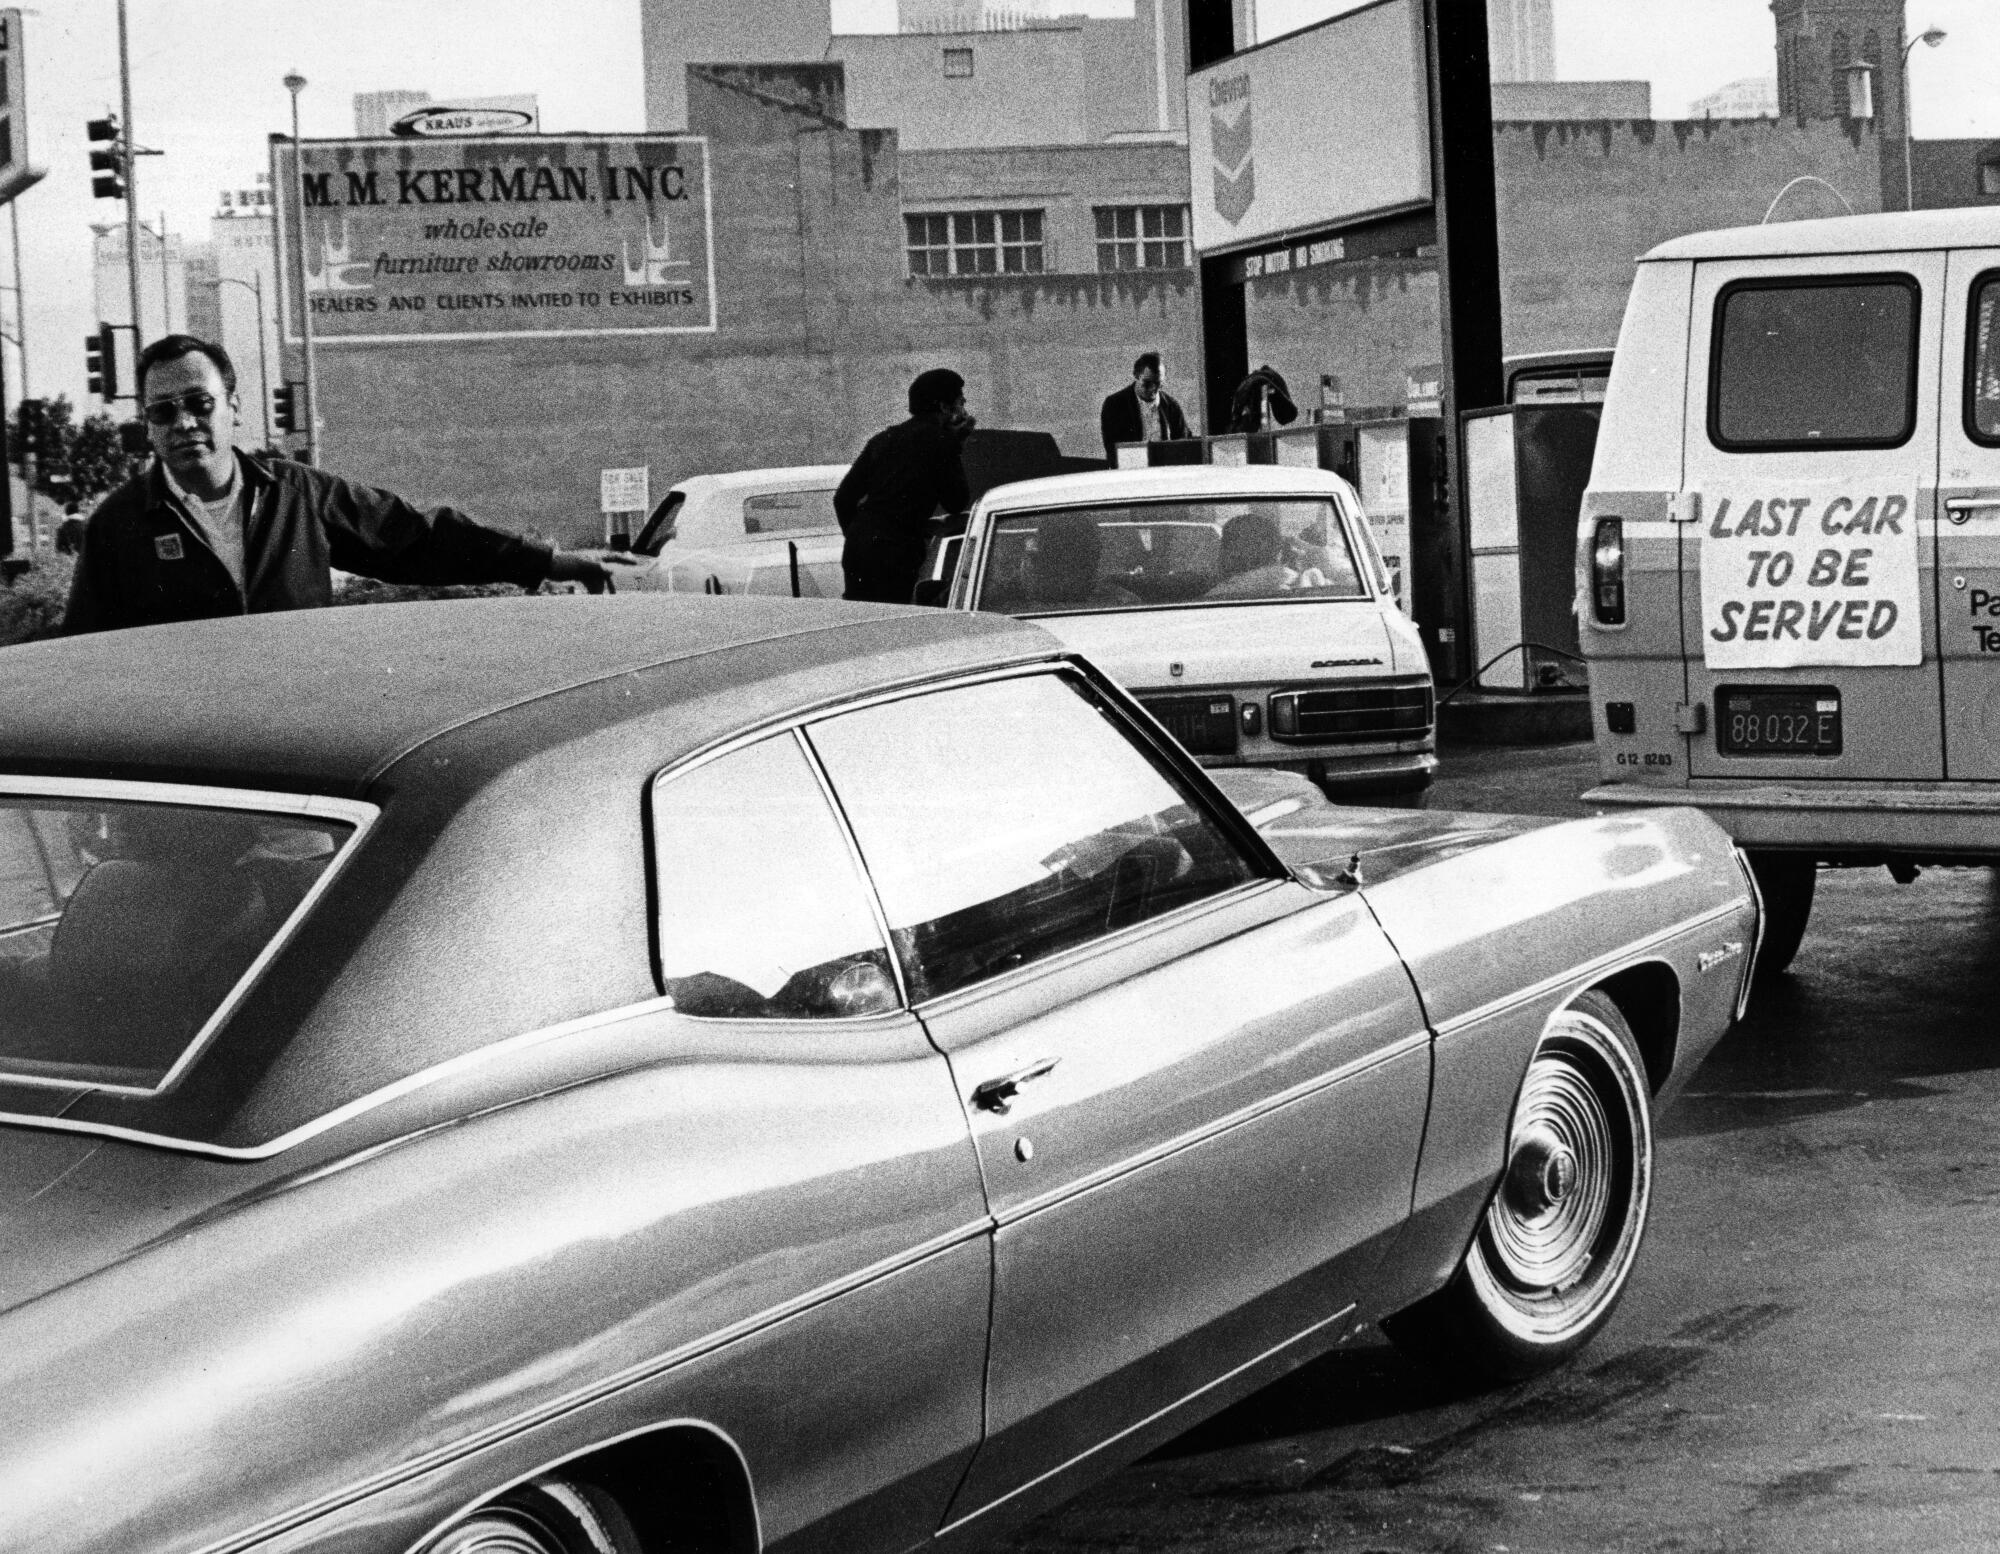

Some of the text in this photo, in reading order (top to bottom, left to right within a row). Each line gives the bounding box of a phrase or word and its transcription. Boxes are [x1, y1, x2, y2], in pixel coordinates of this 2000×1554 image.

[424, 117, 473, 131] KRAUS
[302, 171, 340, 207] M.
[344, 170, 387, 206] M.
[605, 164, 689, 202] INC.
[424, 216, 549, 240] wholesale
[373, 250, 616, 278] furniture showrooms
[388, 295, 426, 311] AND
[437, 292, 505, 310] CLIENTS
[511, 291, 573, 308] INVITED
[577, 291, 601, 307] TO
[609, 289, 694, 306] EXHIBITS
[1709, 494, 1908, 540] LAST CAR
[1745, 548, 1874, 588] TO BE
[1710, 600, 1899, 642] SERVED
